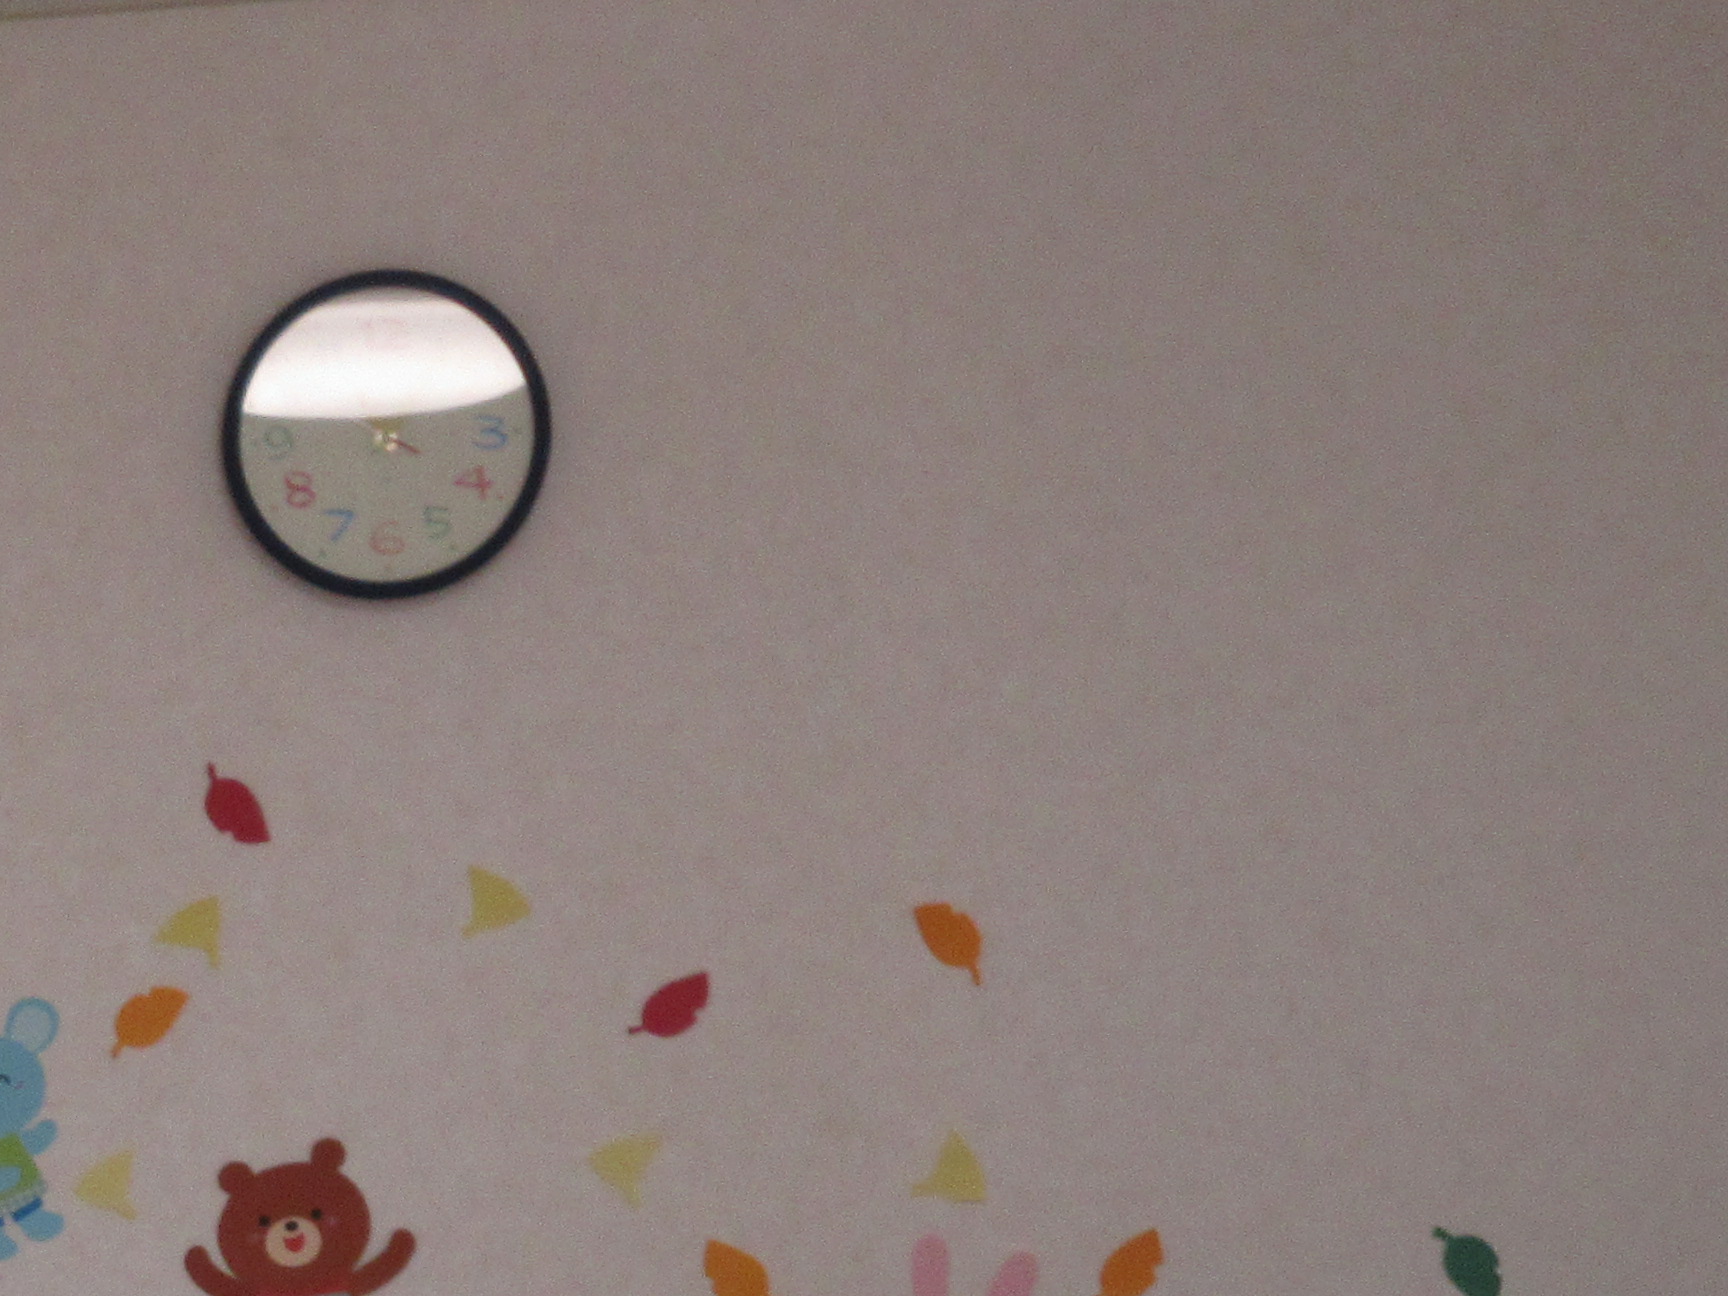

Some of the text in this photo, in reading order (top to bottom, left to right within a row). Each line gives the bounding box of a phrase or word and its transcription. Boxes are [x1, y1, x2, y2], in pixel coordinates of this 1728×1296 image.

[263, 424, 294, 460] 9
[471, 414, 508, 451] 3
[284, 470, 316, 510] 8
[454, 465, 492, 501] 4
[324, 508, 354, 543] 7
[369, 519, 405, 556] 6
[423, 505, 454, 541] 5
